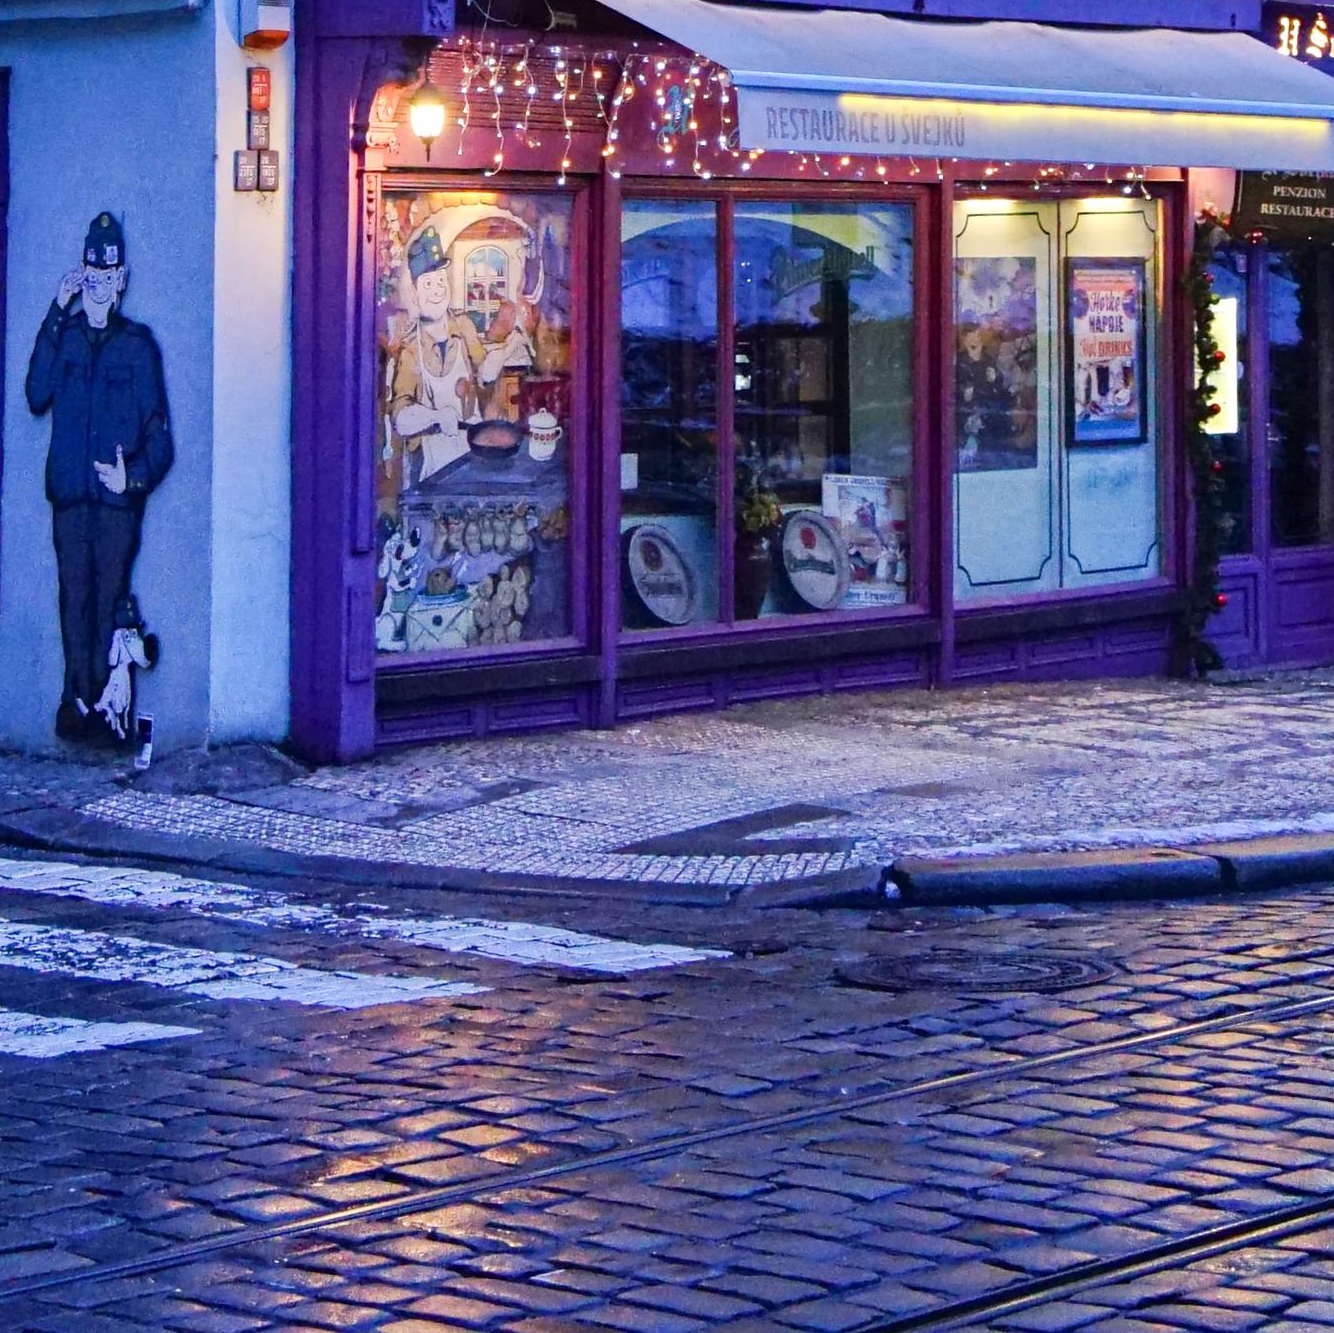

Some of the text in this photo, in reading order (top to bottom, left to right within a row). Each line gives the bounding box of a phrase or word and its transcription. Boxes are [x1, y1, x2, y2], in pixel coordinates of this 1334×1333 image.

[766, 105, 966, 148] RESTAURACE U ŠVEJKŮ
[1272, 185, 1327, 199] PENZION
